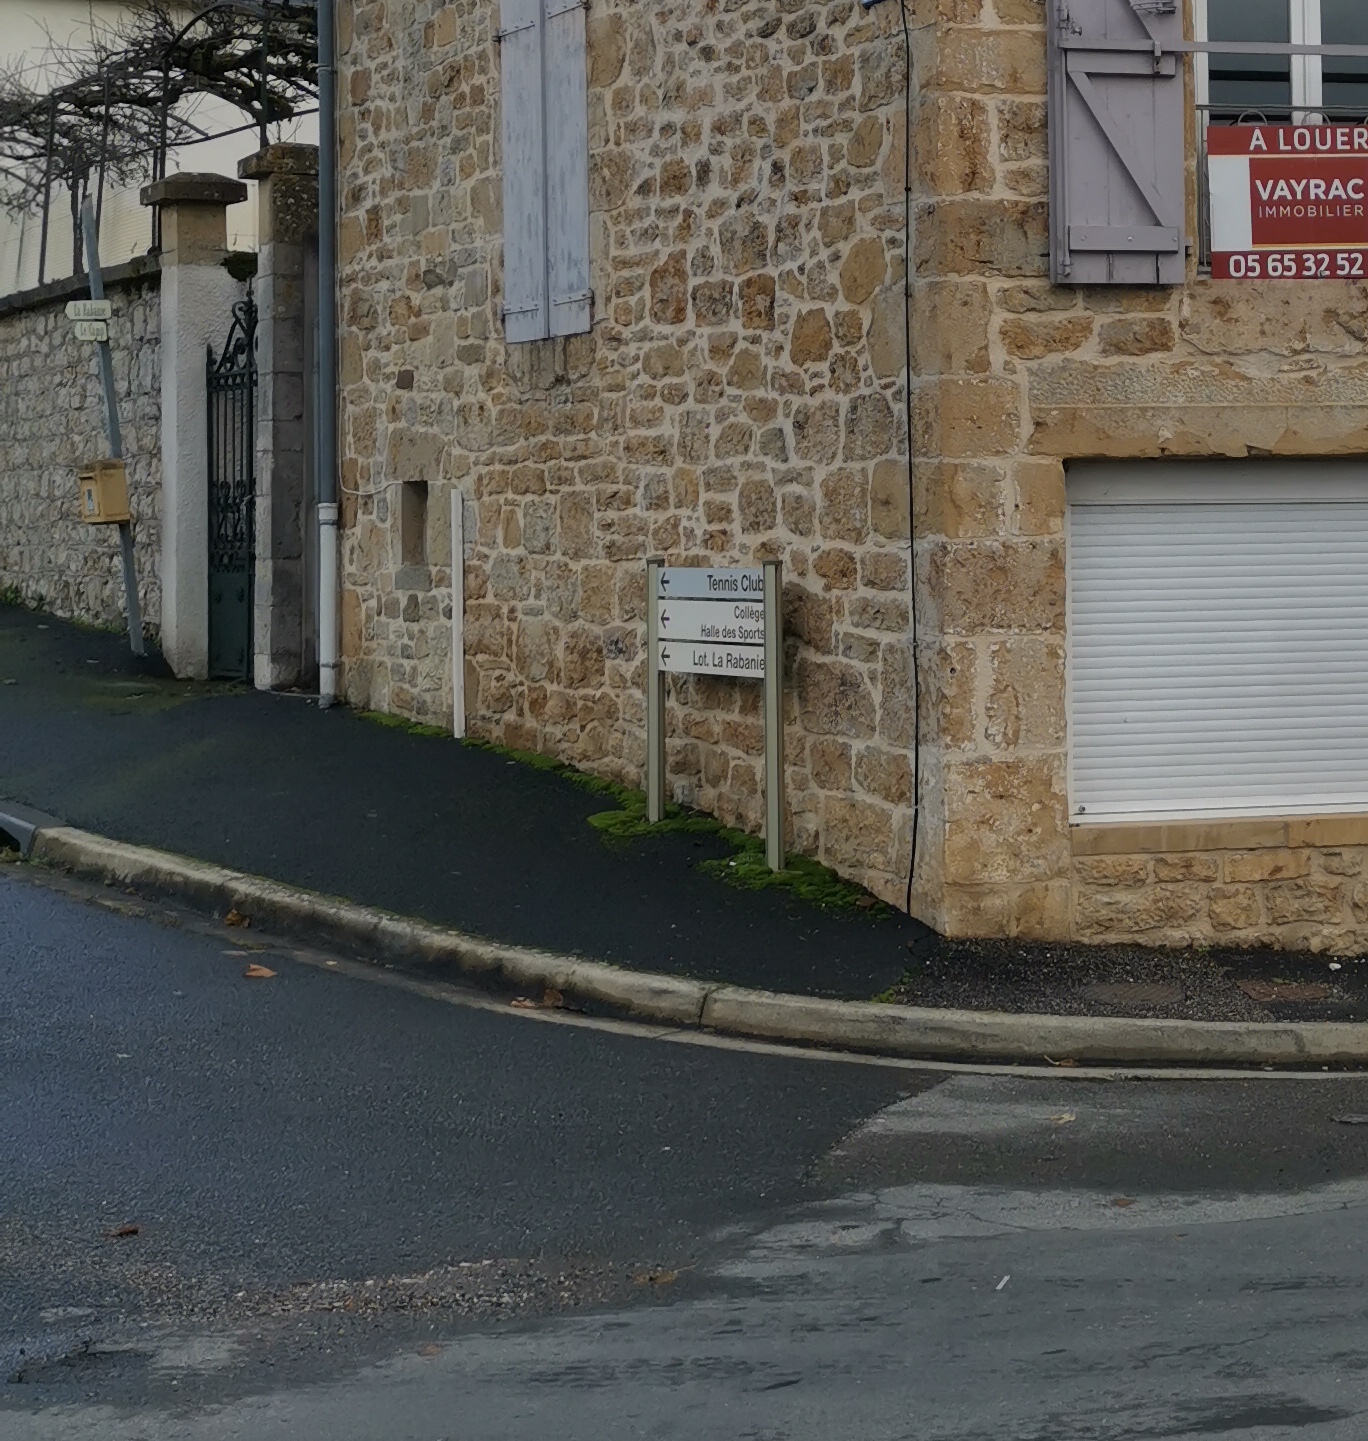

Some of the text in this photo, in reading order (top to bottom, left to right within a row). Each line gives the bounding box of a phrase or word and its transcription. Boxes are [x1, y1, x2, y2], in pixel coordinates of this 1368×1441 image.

[1255, 178, 1365, 201] VAYRAC
[1258, 204, 1365, 218] IMMOBILIER
[1229, 253, 1261, 277] 05
[1266, 253, 1296, 277] 65
[1302, 252, 1330, 277] 32
[1336, 252, 1364, 276] 52
[707, 574, 764, 592] Tennis Club
[734, 605, 765, 623] Collège
[701, 624, 765, 642] Halle des Sports
[693, 650, 765, 671] Lot. La Rabanie
